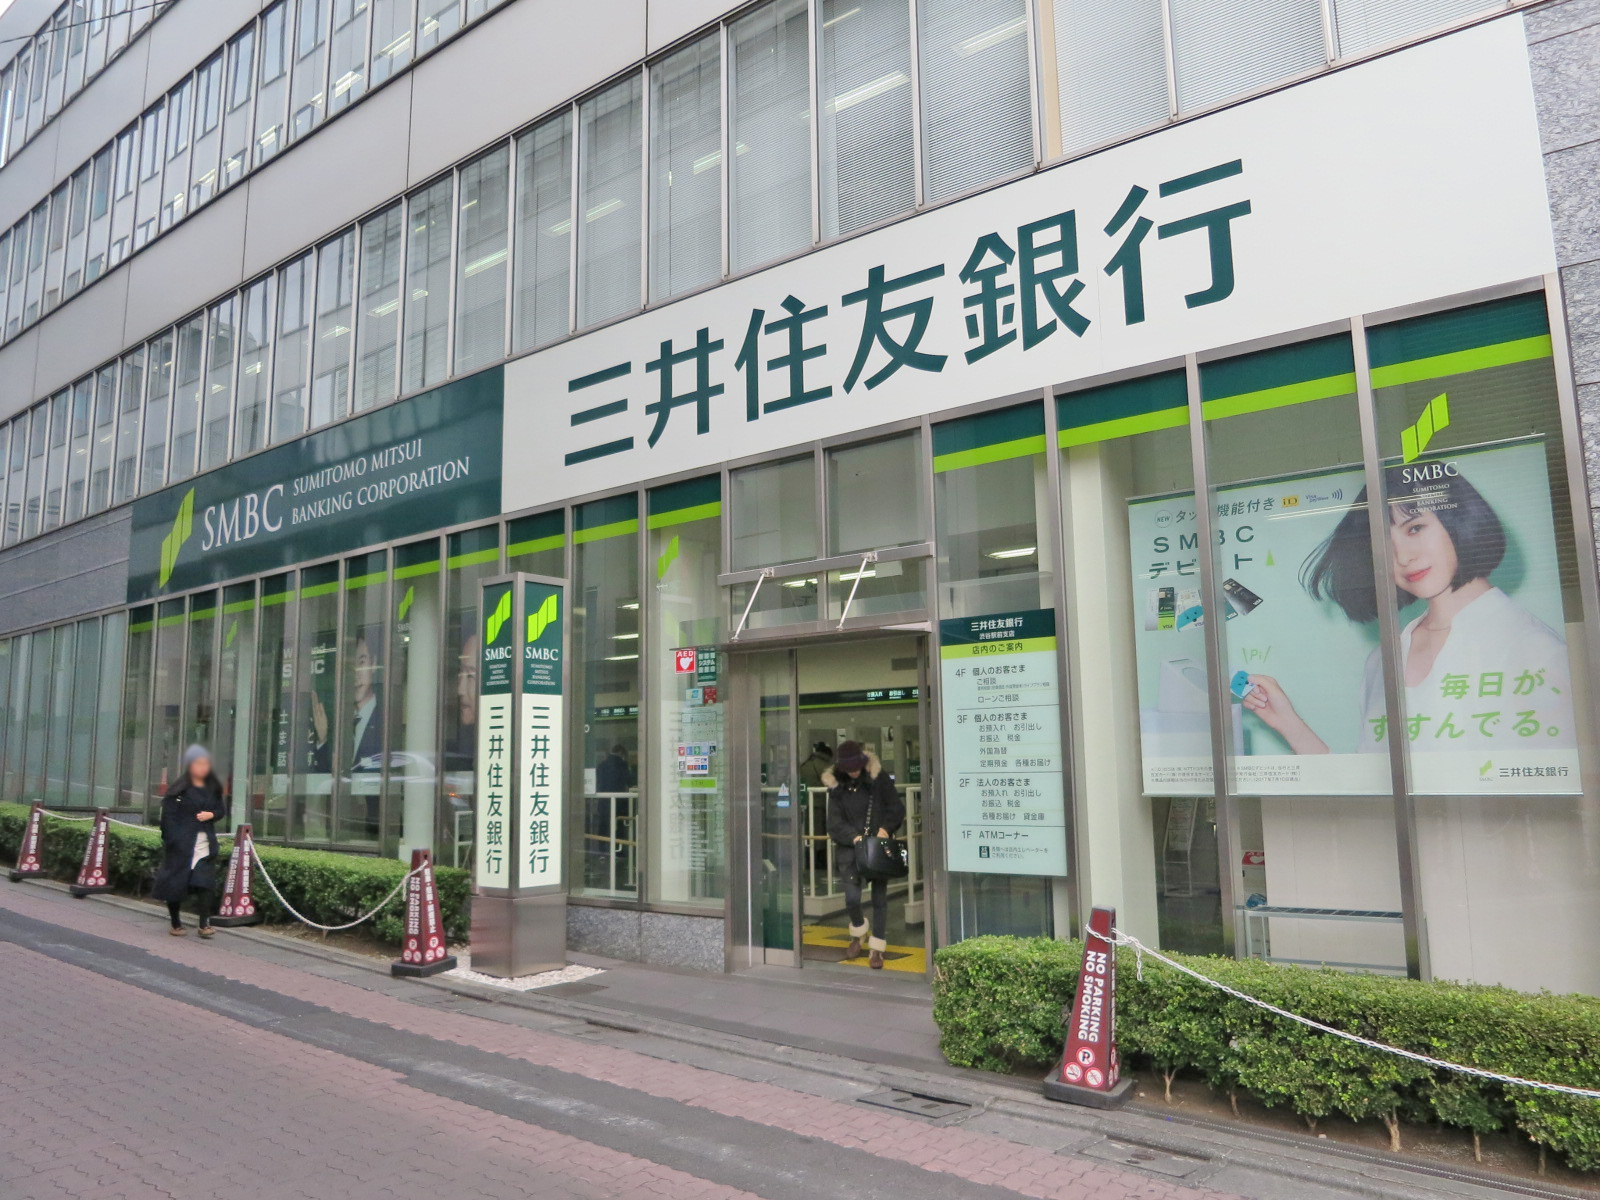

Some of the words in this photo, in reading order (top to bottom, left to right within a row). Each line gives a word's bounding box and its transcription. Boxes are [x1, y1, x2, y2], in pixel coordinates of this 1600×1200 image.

[564, 158, 1252, 467] 三井住友銀行
[293, 457, 367, 497] SUMITOMO
[371, 438, 423, 472] MITSUI
[1402, 462, 1458, 484] SMBC
[292, 491, 353, 526] BANKING
[357, 456, 470, 506] CORPORATION
[1412, 483, 1450, 493] SUMITOMO
[1416, 498, 1448, 506] BANKING
[1176, 497, 1275, 523] タッ機能付き
[1409, 503, 1458, 514] CORPORATION
[202, 484, 284, 552] SMBC
[1156, 515, 1171, 523] NEW
[1149, 553, 1253, 579] デビト
[970, 617, 1024, 632] 三井住友銀行
[485, 646, 512, 660] SMBC
[525, 646, 559, 661] SMBC
[972, 642, 1023, 654] 店内のご案内
[955, 668, 966, 678] 4F
[972, 664, 1026, 676] 個人のお客さま
[976, 678, 996, 686] ご相談
[1440, 668, 1562, 700] 毎日が、
[978, 694, 1020, 703] ローンご相談
[957, 714, 968, 724] 3F
[974, 712, 1028, 722] 個人のお客さま
[1014, 723, 1042, 731] お引出し
[1368, 710, 1560, 742] すすんでる。
[1007, 734, 1020, 742] 税金
[980, 747, 1008, 755] 外国為替
[980, 760, 1008, 768] 定期預金
[1015, 759, 1051, 767] 各種お届け
[1499, 766, 1569, 778] 三井住友銀行
[960, 778, 970, 788] 2F
[976, 778, 1030, 787] 法人のお客さま
[486, 706, 505, 875] 三井住友銀行
[529, 706, 551, 875] 三井住友銀行
[1007, 800, 1020, 808] 税金
[982, 812, 1016, 820] 各種お届け
[962, 830, 972, 839] 1F
[979, 830, 1029, 840] ATMコーナー
[1085, 950, 1096, 972] NO
[1096, 952, 1107, 974] NO
[1078, 974, 1094, 1041] SMOKING
[1088, 978, 1105, 1043] PARKING
